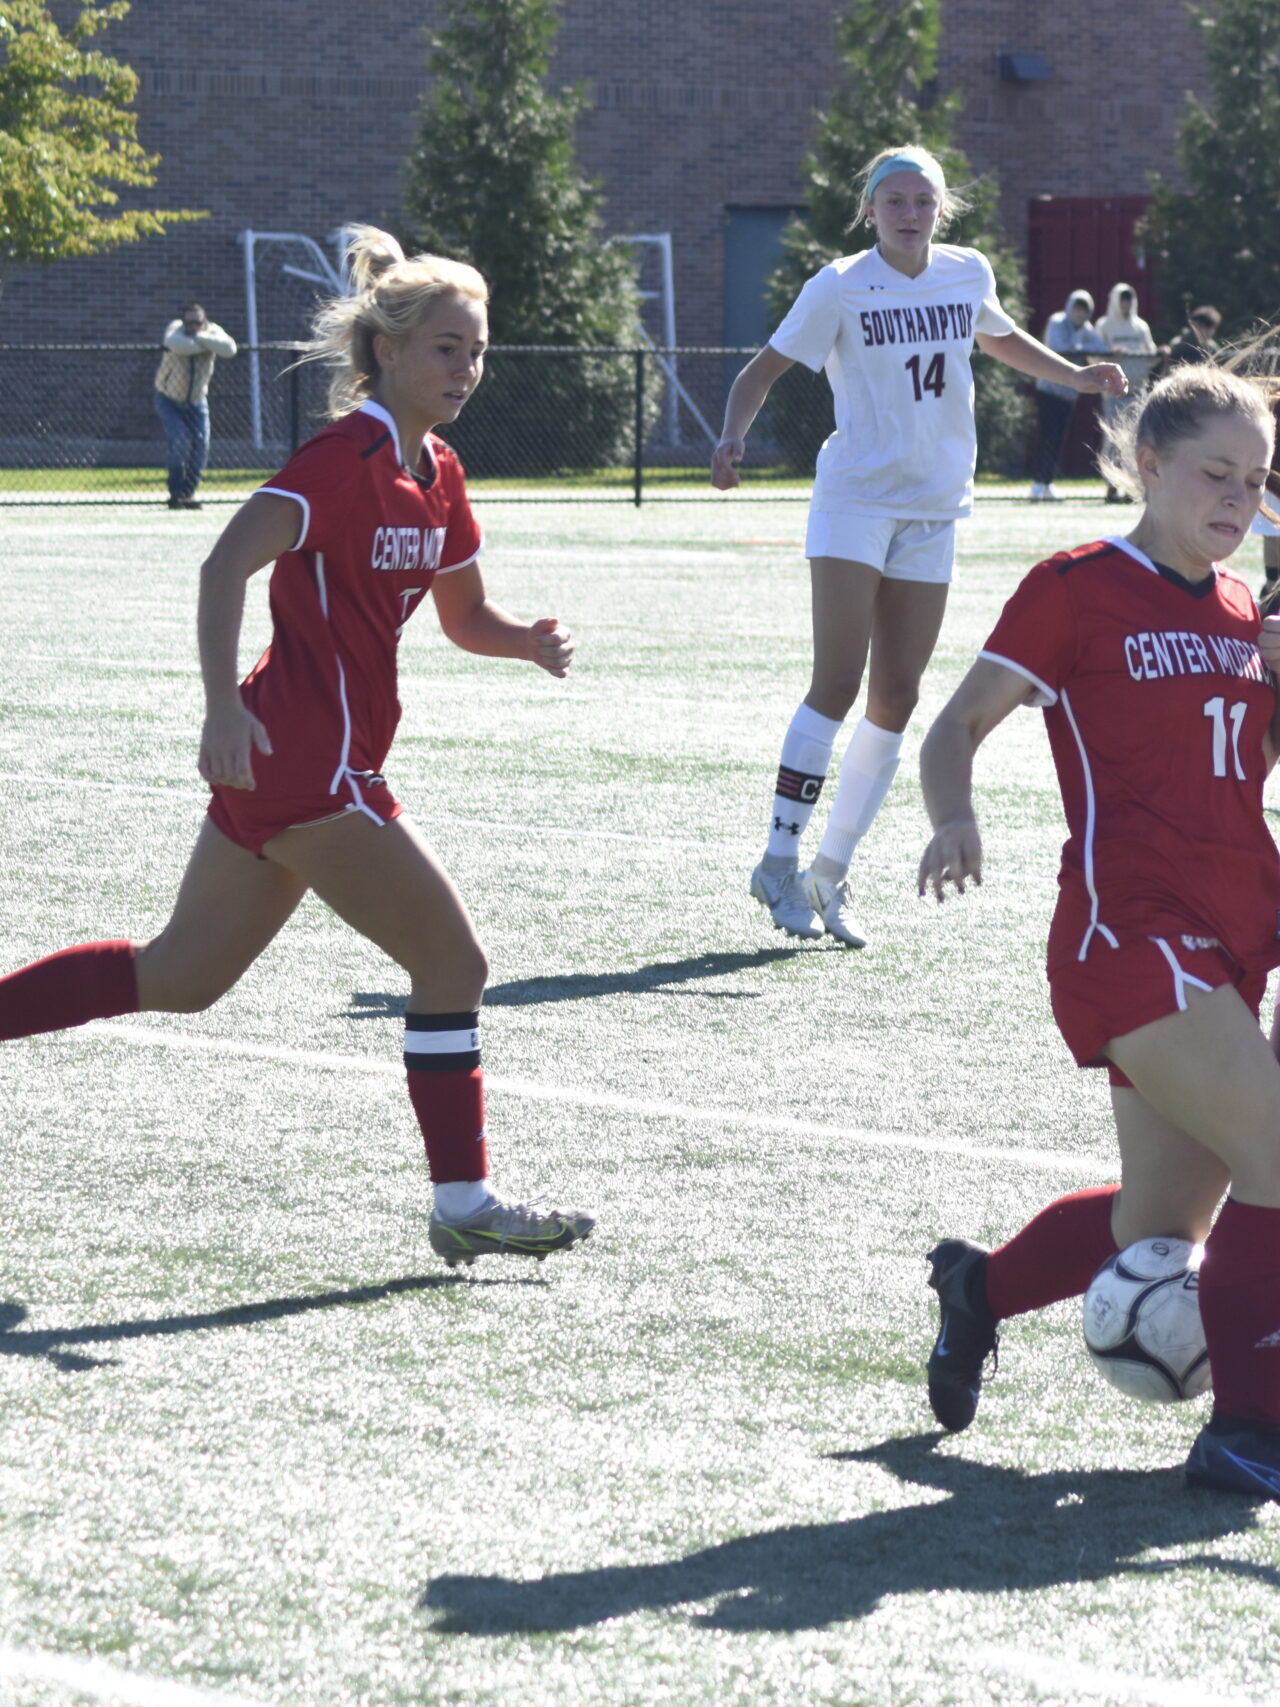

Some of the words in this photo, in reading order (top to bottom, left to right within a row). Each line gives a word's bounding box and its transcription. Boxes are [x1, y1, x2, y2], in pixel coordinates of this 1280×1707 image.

[860, 303, 973, 347] SOUTHAMPTON
[905, 352, 946, 402] 14
[371, 526, 421, 571] CENTER
[1124, 632, 1215, 681] CENTER
[1203, 697, 1248, 780] 11
[800, 779, 819, 800] C
